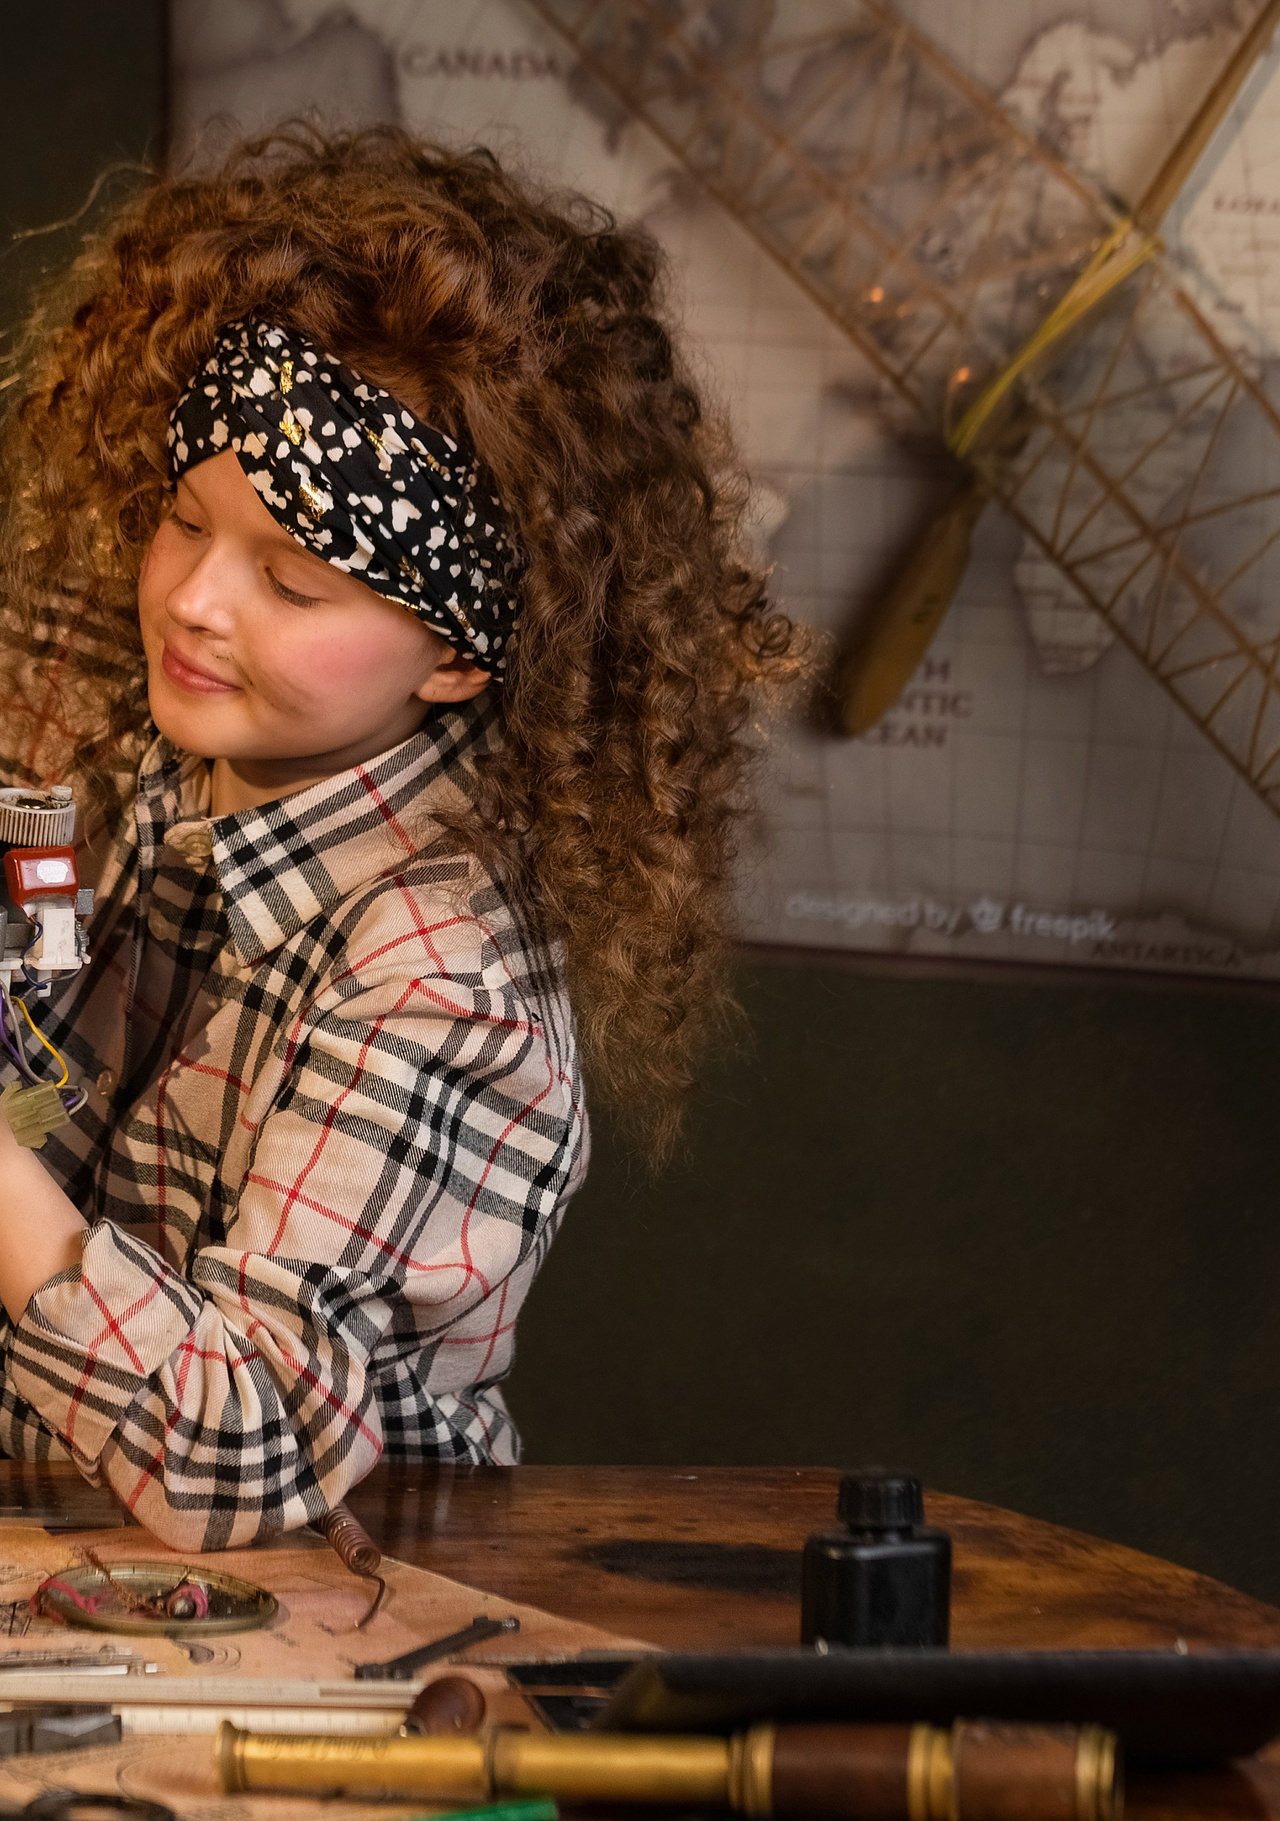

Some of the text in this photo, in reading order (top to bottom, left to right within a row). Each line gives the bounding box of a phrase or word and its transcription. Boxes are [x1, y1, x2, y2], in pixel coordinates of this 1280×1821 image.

[400, 45, 566, 81] CANADA
[785, 894, 1116, 944] designed by freepik
